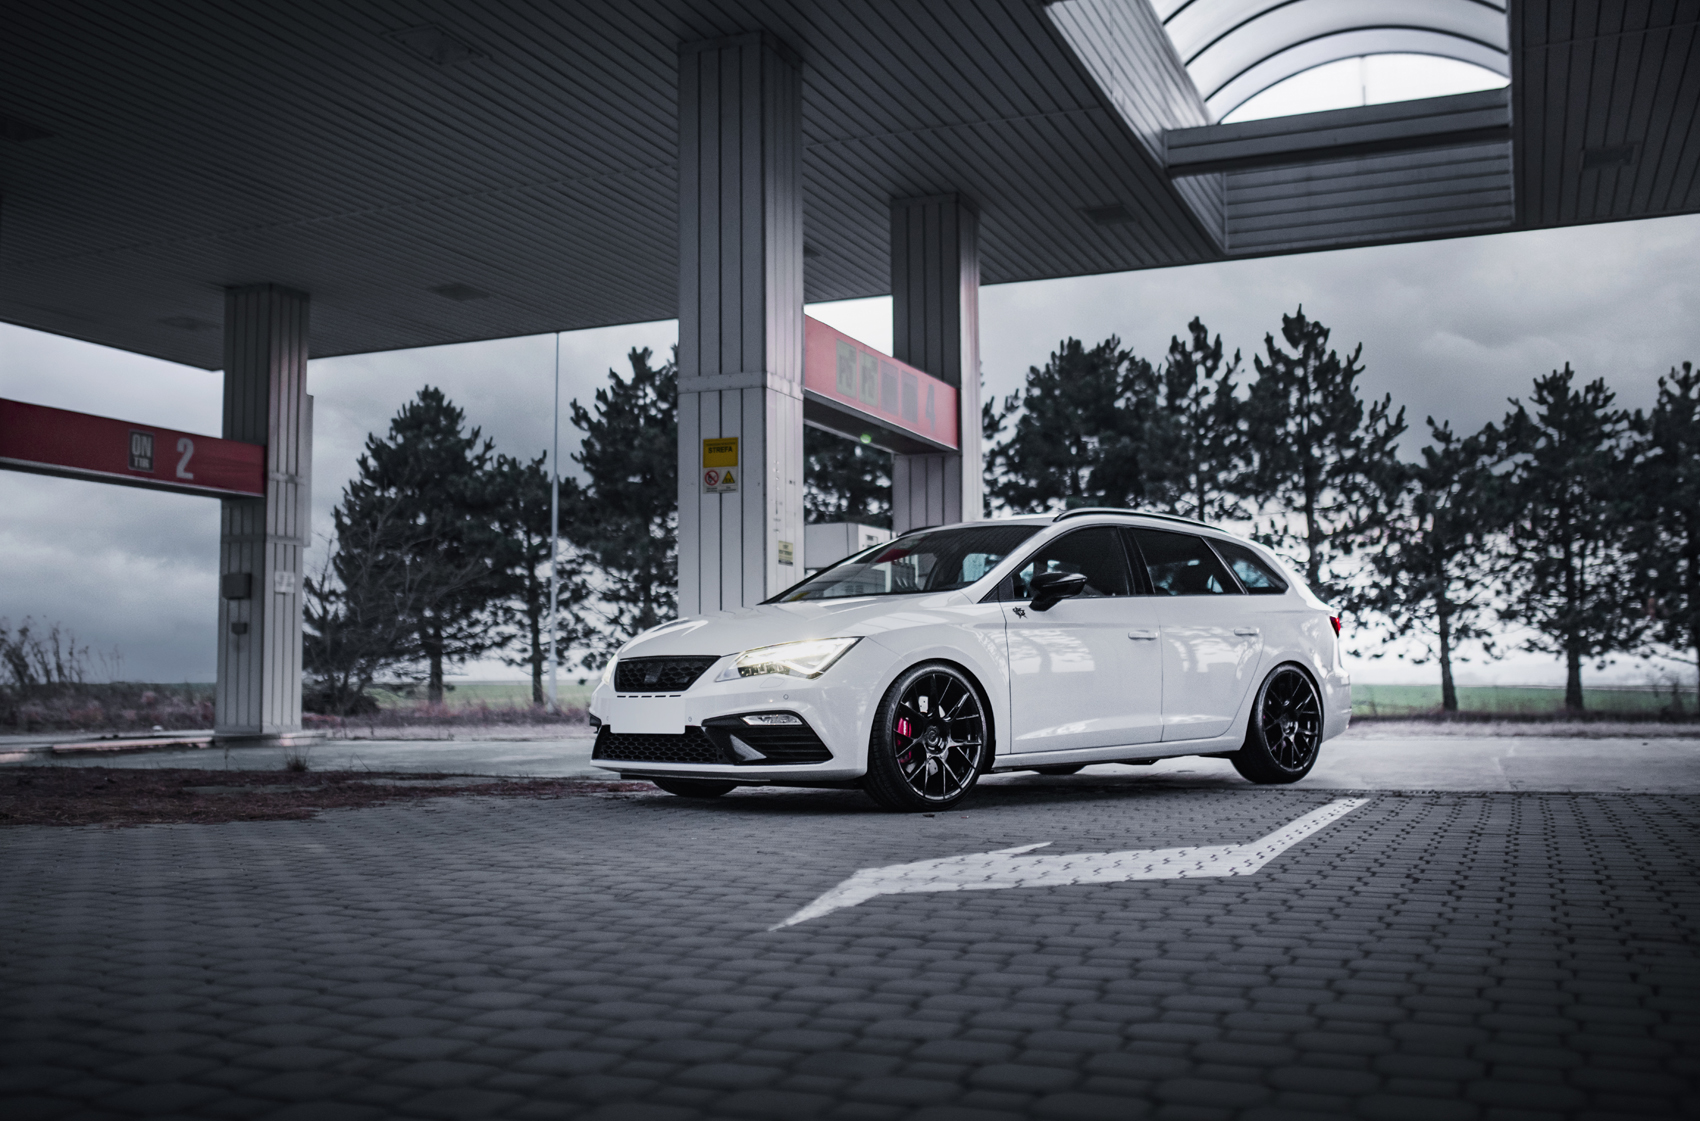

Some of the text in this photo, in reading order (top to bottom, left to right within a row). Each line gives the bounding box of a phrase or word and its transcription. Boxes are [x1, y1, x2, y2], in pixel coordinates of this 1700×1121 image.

[132, 434, 151, 457] ON
[708, 446, 733, 454] STREFA
[134, 457, 149, 468] TIR
[176, 437, 194, 479] 2
